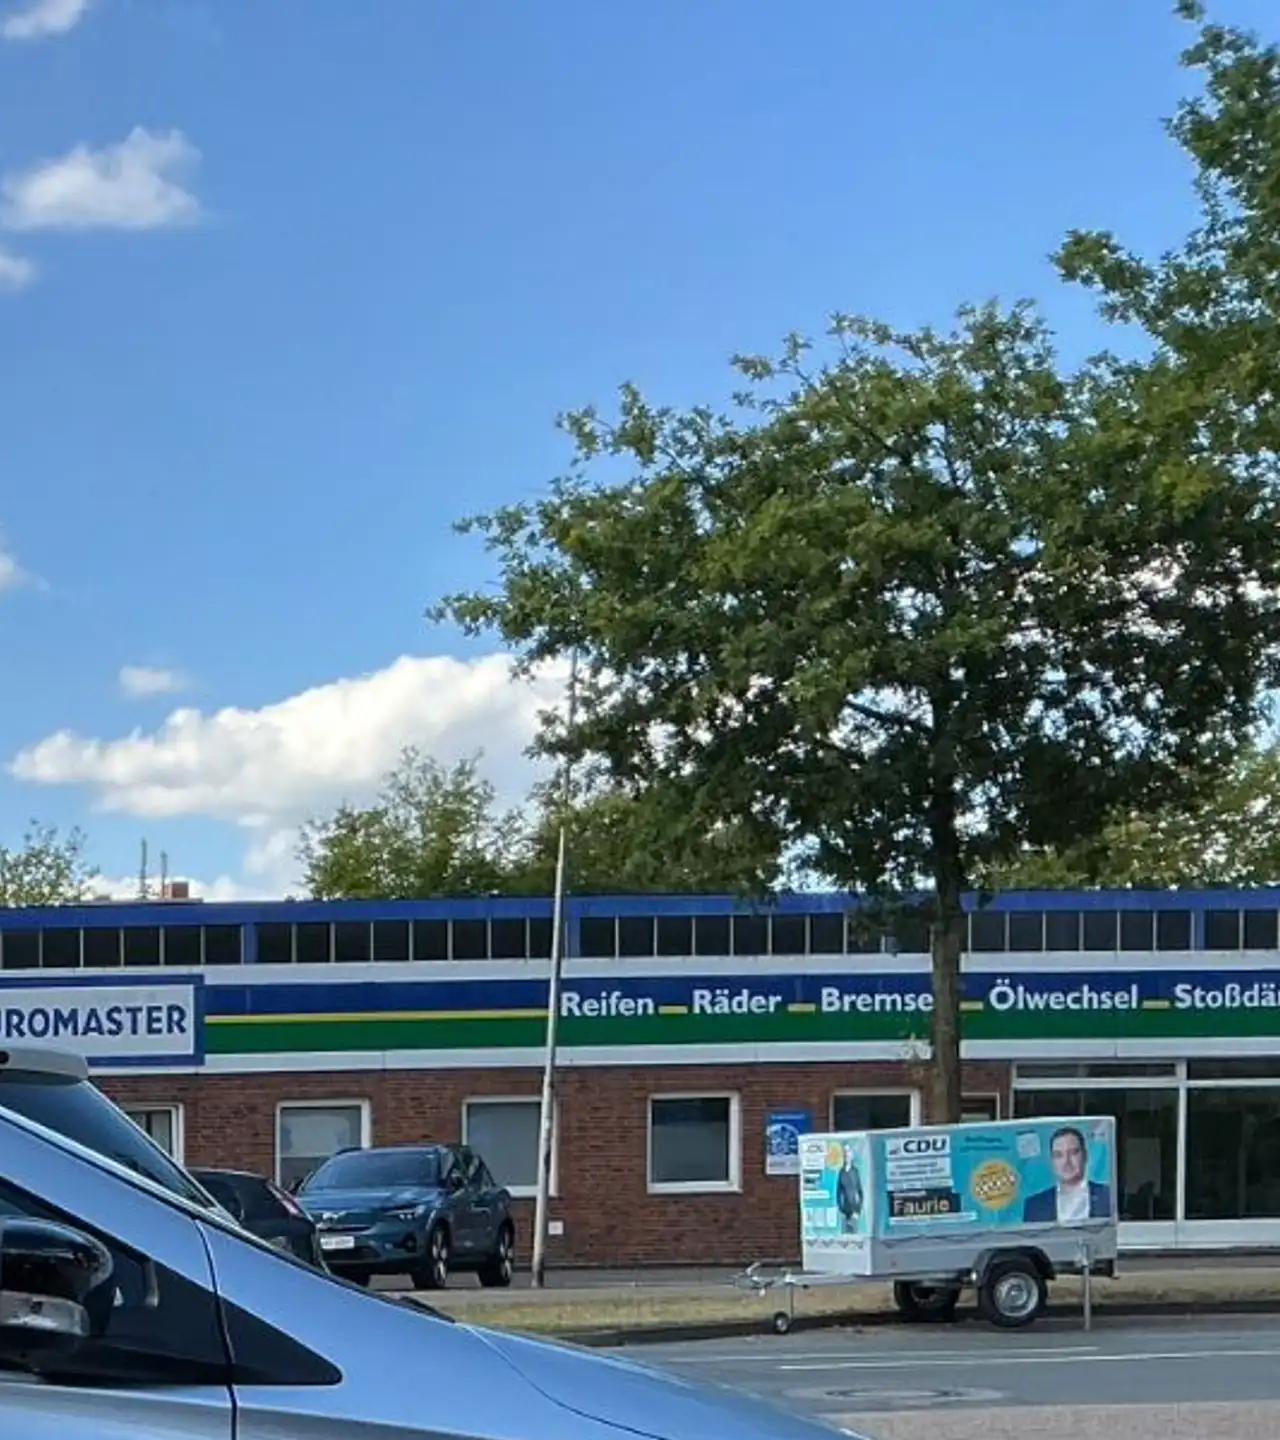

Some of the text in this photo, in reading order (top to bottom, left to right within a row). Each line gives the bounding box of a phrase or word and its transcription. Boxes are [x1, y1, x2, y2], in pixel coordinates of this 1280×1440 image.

[560, 991, 655, 1017] Reifen
[692, 988, 782, 1015] Räder
[820, 986, 934, 1014] Bremse
[989, 978, 1138, 1011] Ölwechsel
[902, 1137, 947, 1154] CDU
